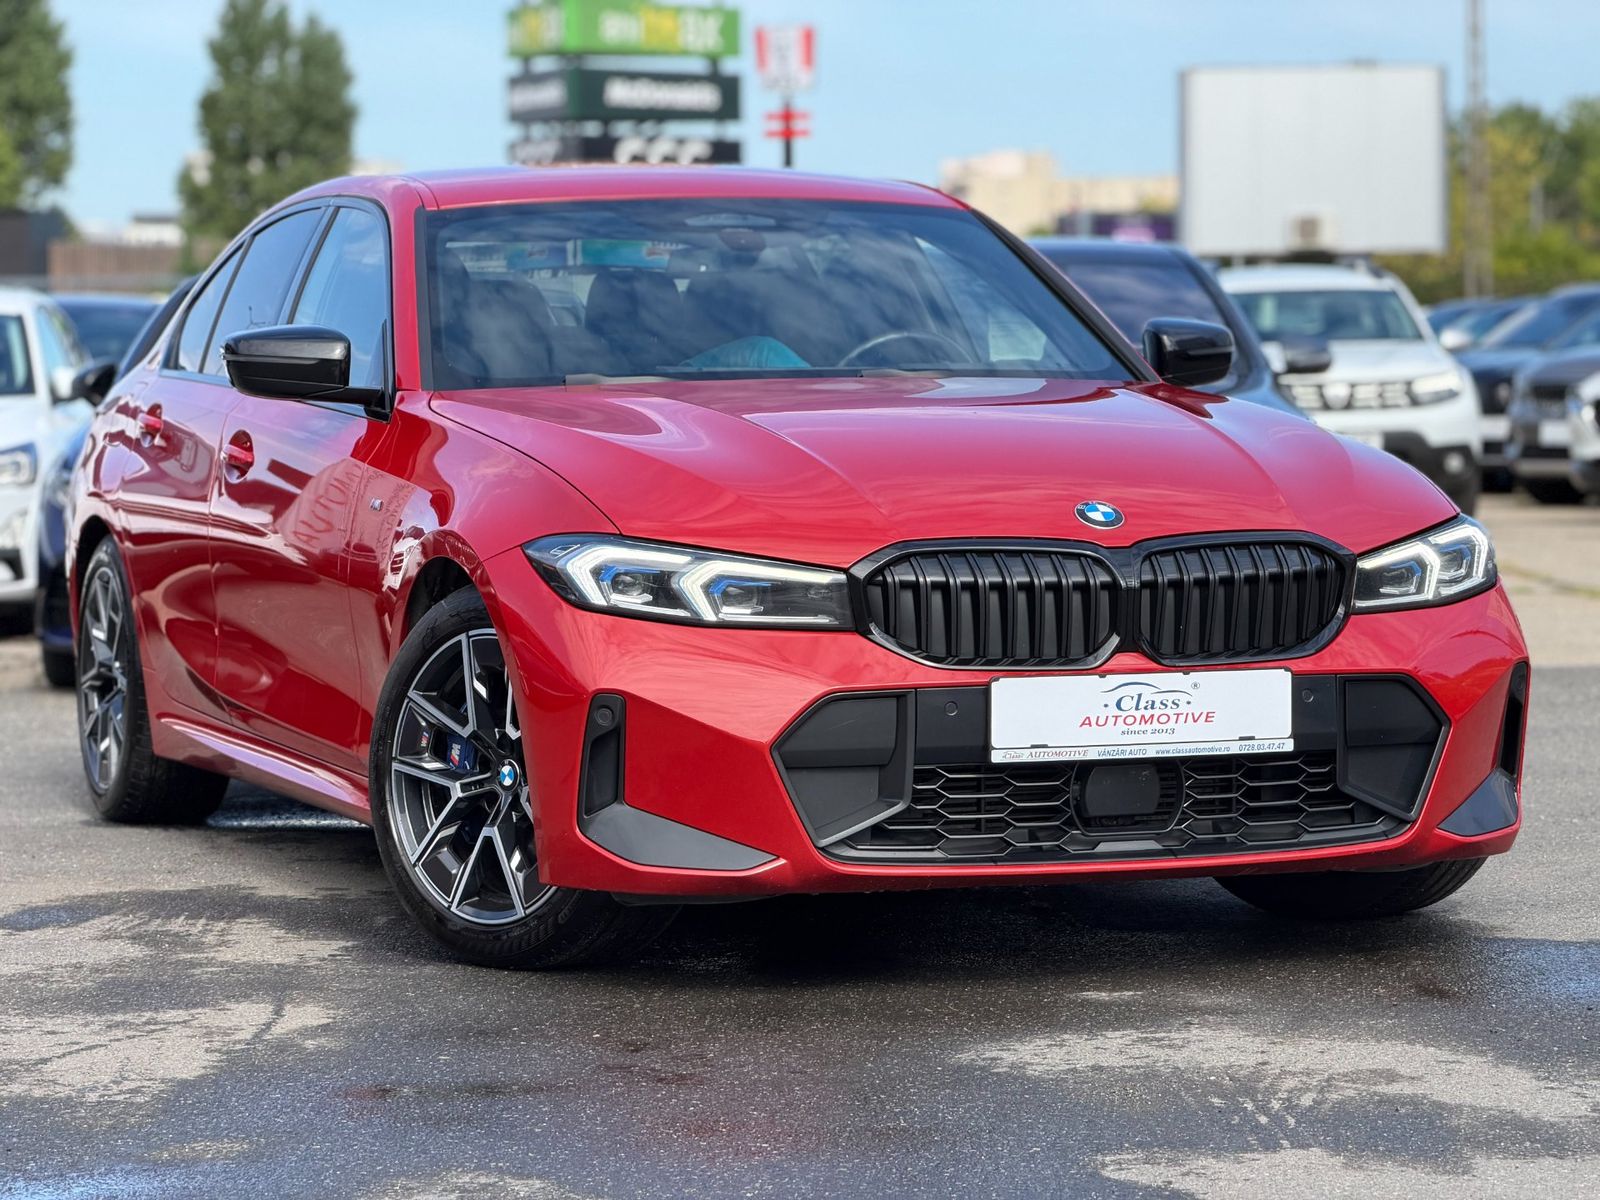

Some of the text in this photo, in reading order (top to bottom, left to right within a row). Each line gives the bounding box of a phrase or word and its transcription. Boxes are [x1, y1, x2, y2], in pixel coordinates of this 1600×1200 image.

[1115, 693, 1181, 712] Class
[1080, 711, 1216, 728] AUTOMOTIVE
[1121, 727, 1175, 736] since 2013
[1026, 749, 1088, 759] AUTOMOTIVE
[1129, 748, 1147, 756] AUTO
[1155, 745, 1231, 755] www.classautomotive.ro
[1238, 742, 1286, 752] 0728.03.47.47
